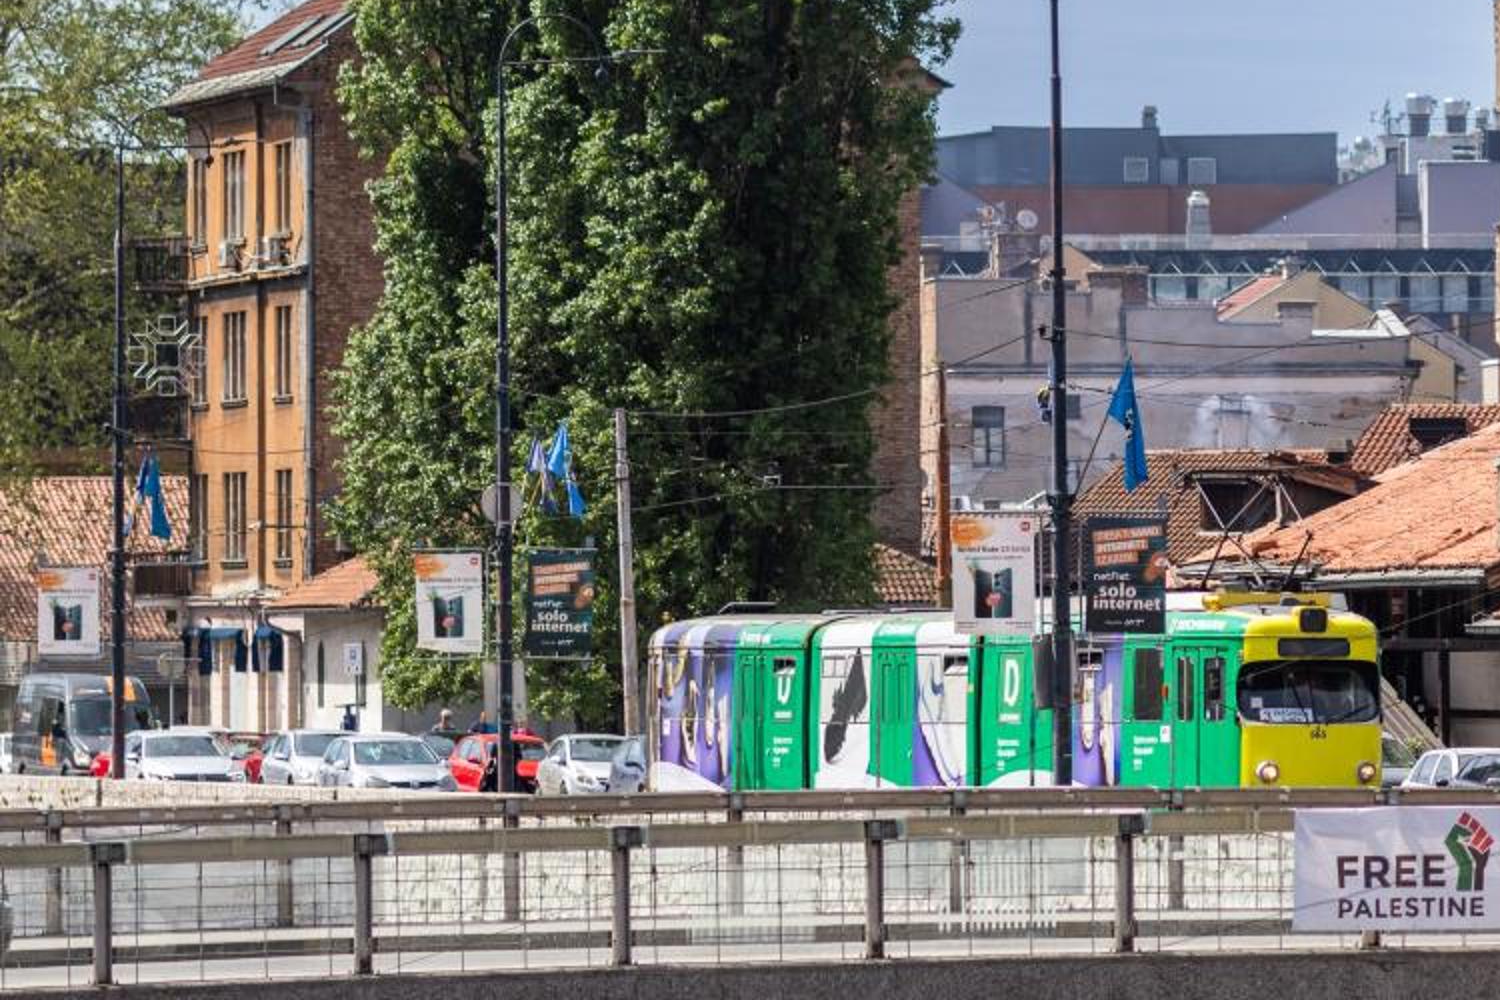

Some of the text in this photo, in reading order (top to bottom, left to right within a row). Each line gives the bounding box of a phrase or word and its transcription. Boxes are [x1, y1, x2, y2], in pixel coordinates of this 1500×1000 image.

[1099, 582, 1137, 598] solo
[1093, 596, 1162, 611] internet
[537, 610, 568, 622] solo
[531, 619, 589, 633] internet
[1336, 854, 1446, 889] FREE
[1337, 896, 1485, 919] PALESTINE
